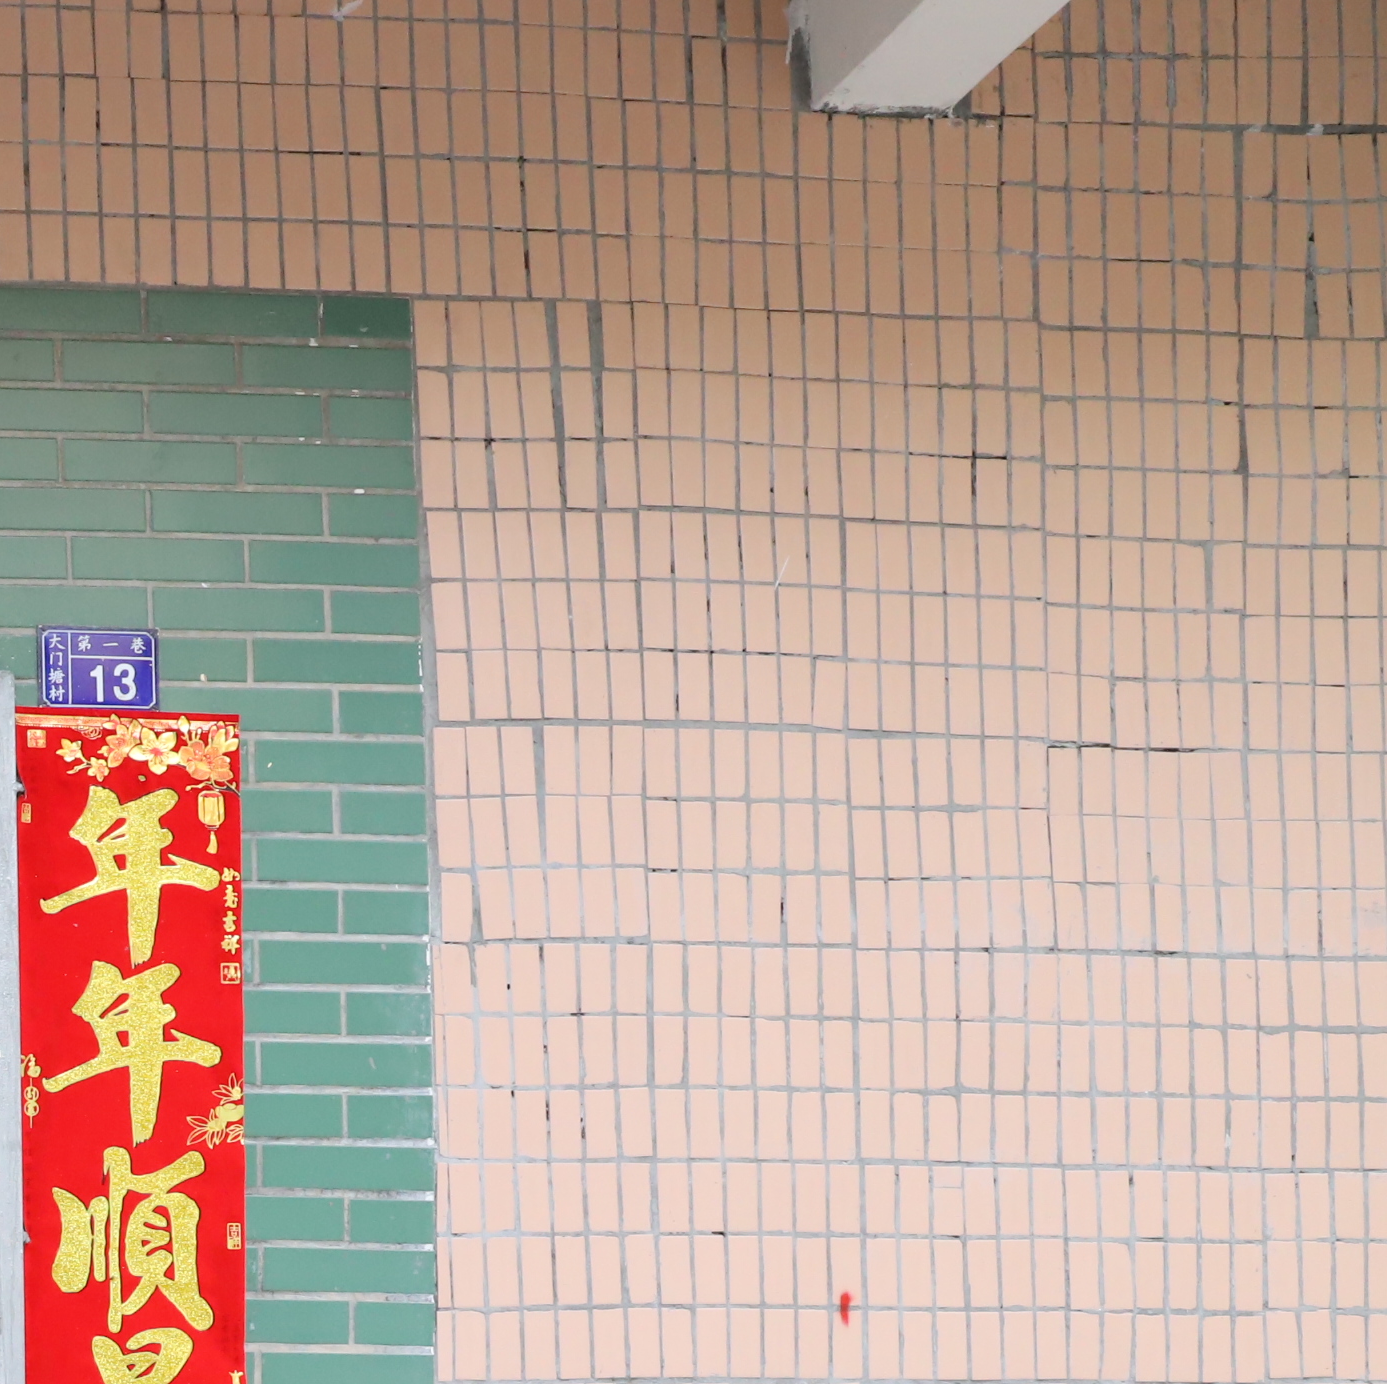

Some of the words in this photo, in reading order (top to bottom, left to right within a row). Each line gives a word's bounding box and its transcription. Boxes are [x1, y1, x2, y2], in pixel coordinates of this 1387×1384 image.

[77, 634, 147, 655] 第一巷
[48, 633, 66, 702] 大门塘村
[89, 663, 137, 703] 13
